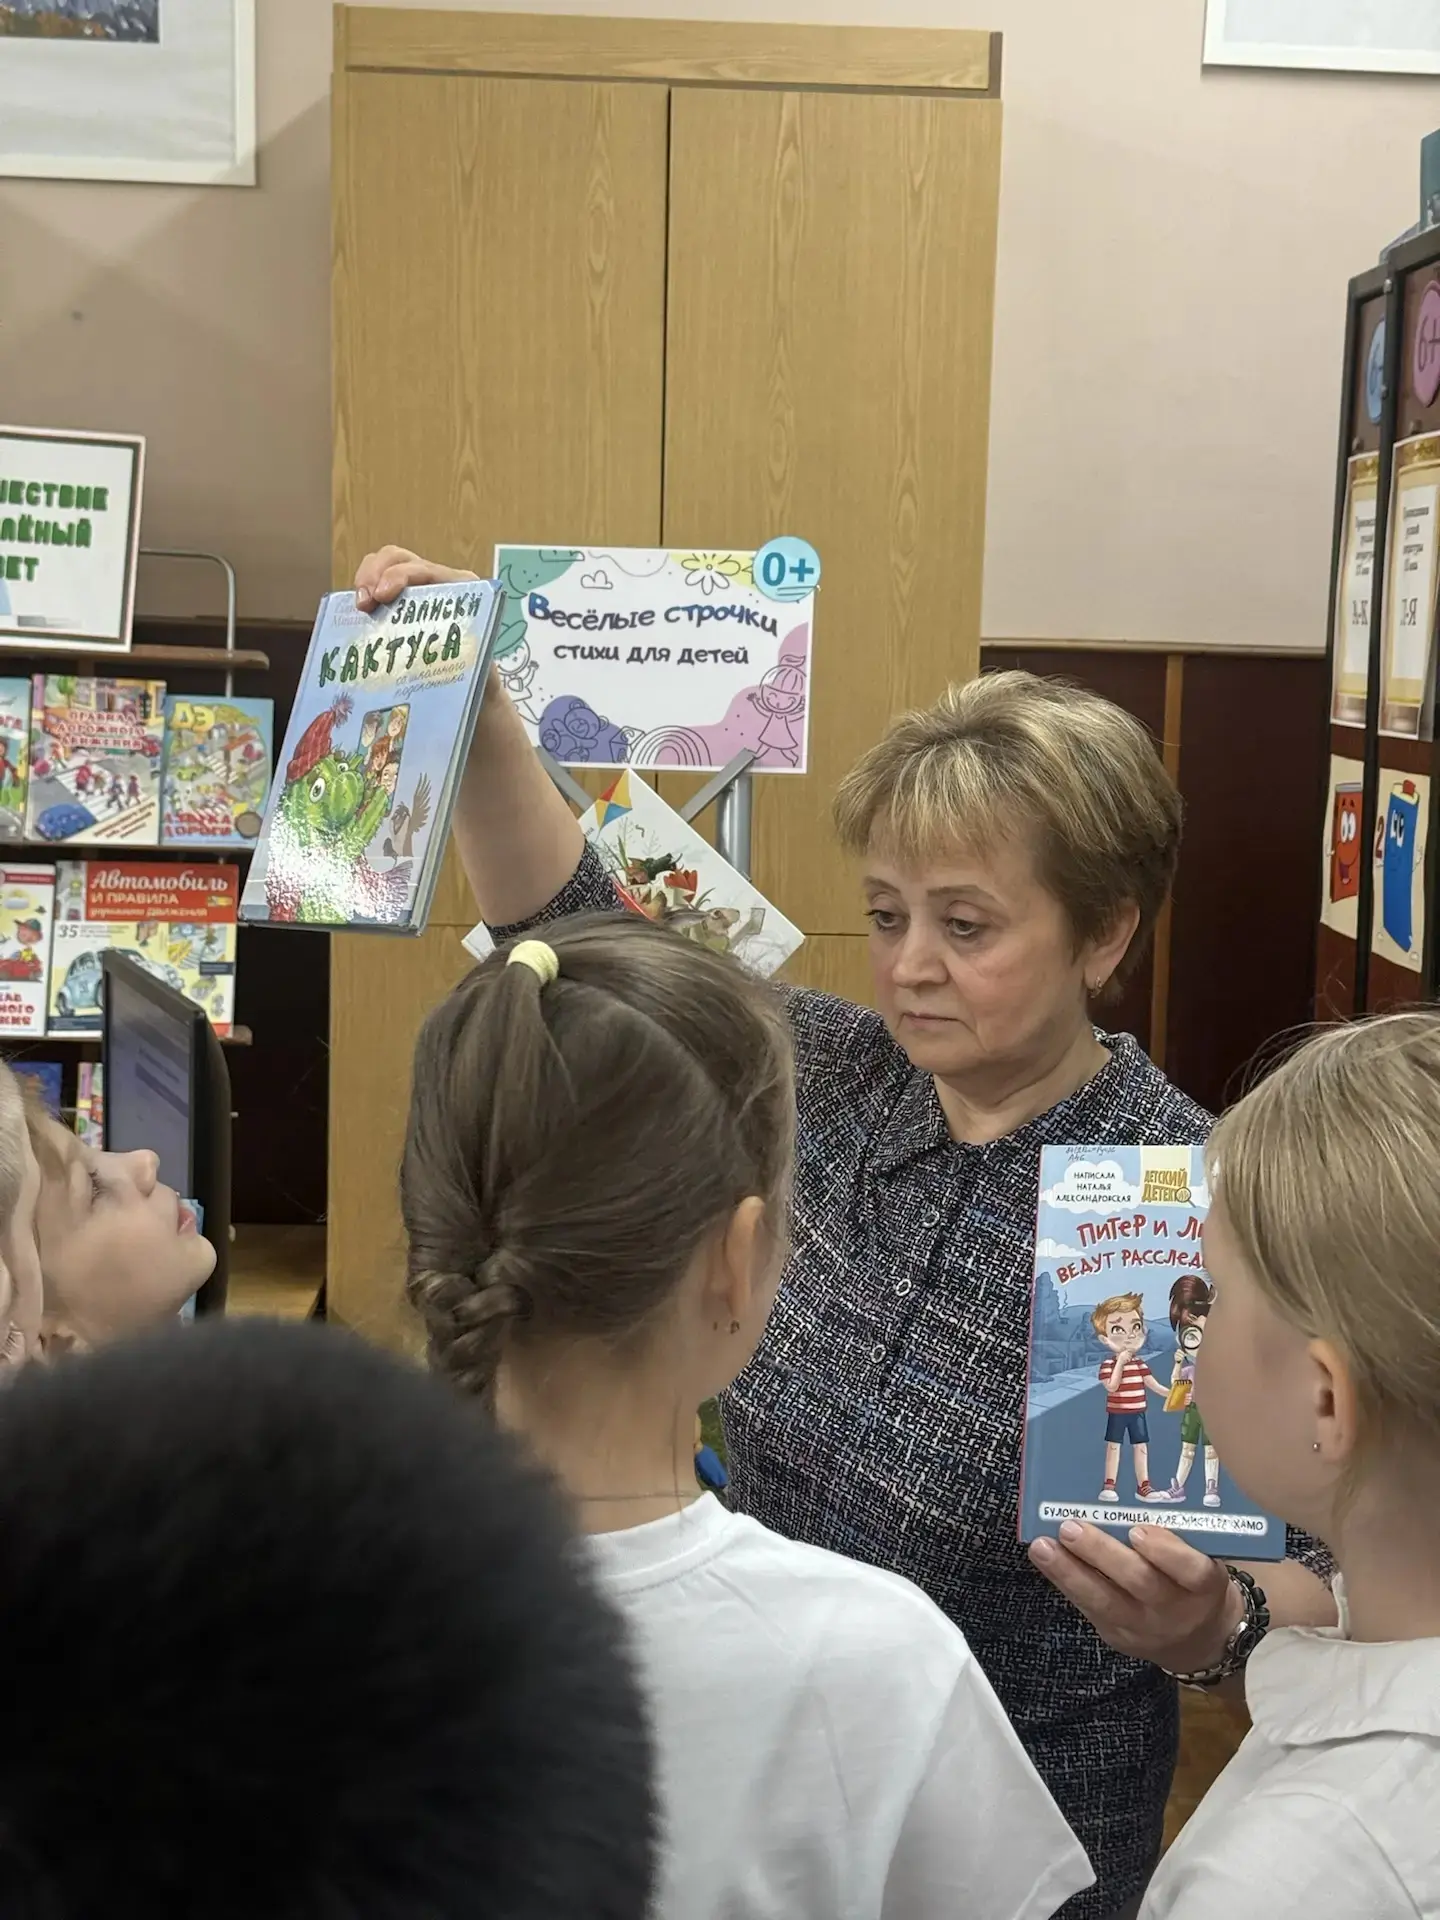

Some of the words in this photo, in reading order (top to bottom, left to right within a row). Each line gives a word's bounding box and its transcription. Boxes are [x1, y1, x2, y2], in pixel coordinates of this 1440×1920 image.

[762, 551, 815, 587] 0+
[391, 592, 481, 625] ЗАПИСКИ
[528, 592, 656, 631] Весёлые
[664, 604, 778, 637] строчки
[320, 622, 463, 688] КАКТУСА
[553, 644, 620, 662] стихи
[626, 647, 670, 664] для
[677, 646, 749, 666] детей
[91, 868, 228, 892] Автомобиль
[92, 892, 104, 903] И
[107, 893, 179, 905] ПРАВИЛА
[59, 924, 79, 938] 35
[1074, 1171, 1116, 1180] НАПИСАЛА
[1076, 1183, 1111, 1191] НАТАЛЬЯ
[1144, 1168, 1188, 1187] ДЕТСКИЙ
[1055, 1194, 1131, 1203] АЛЕКСАНДРОВСКАЯ
[1056, 1252, 1115, 1284] ВЕДУТ
[1044, 1506, 1087, 1518] БУЛОЧКА
[1092, 1511, 1099, 1520] С
[1104, 1510, 1150, 1523] КОРИЦЕЙ
[1233, 1520, 1264, 1531] ХАМО
